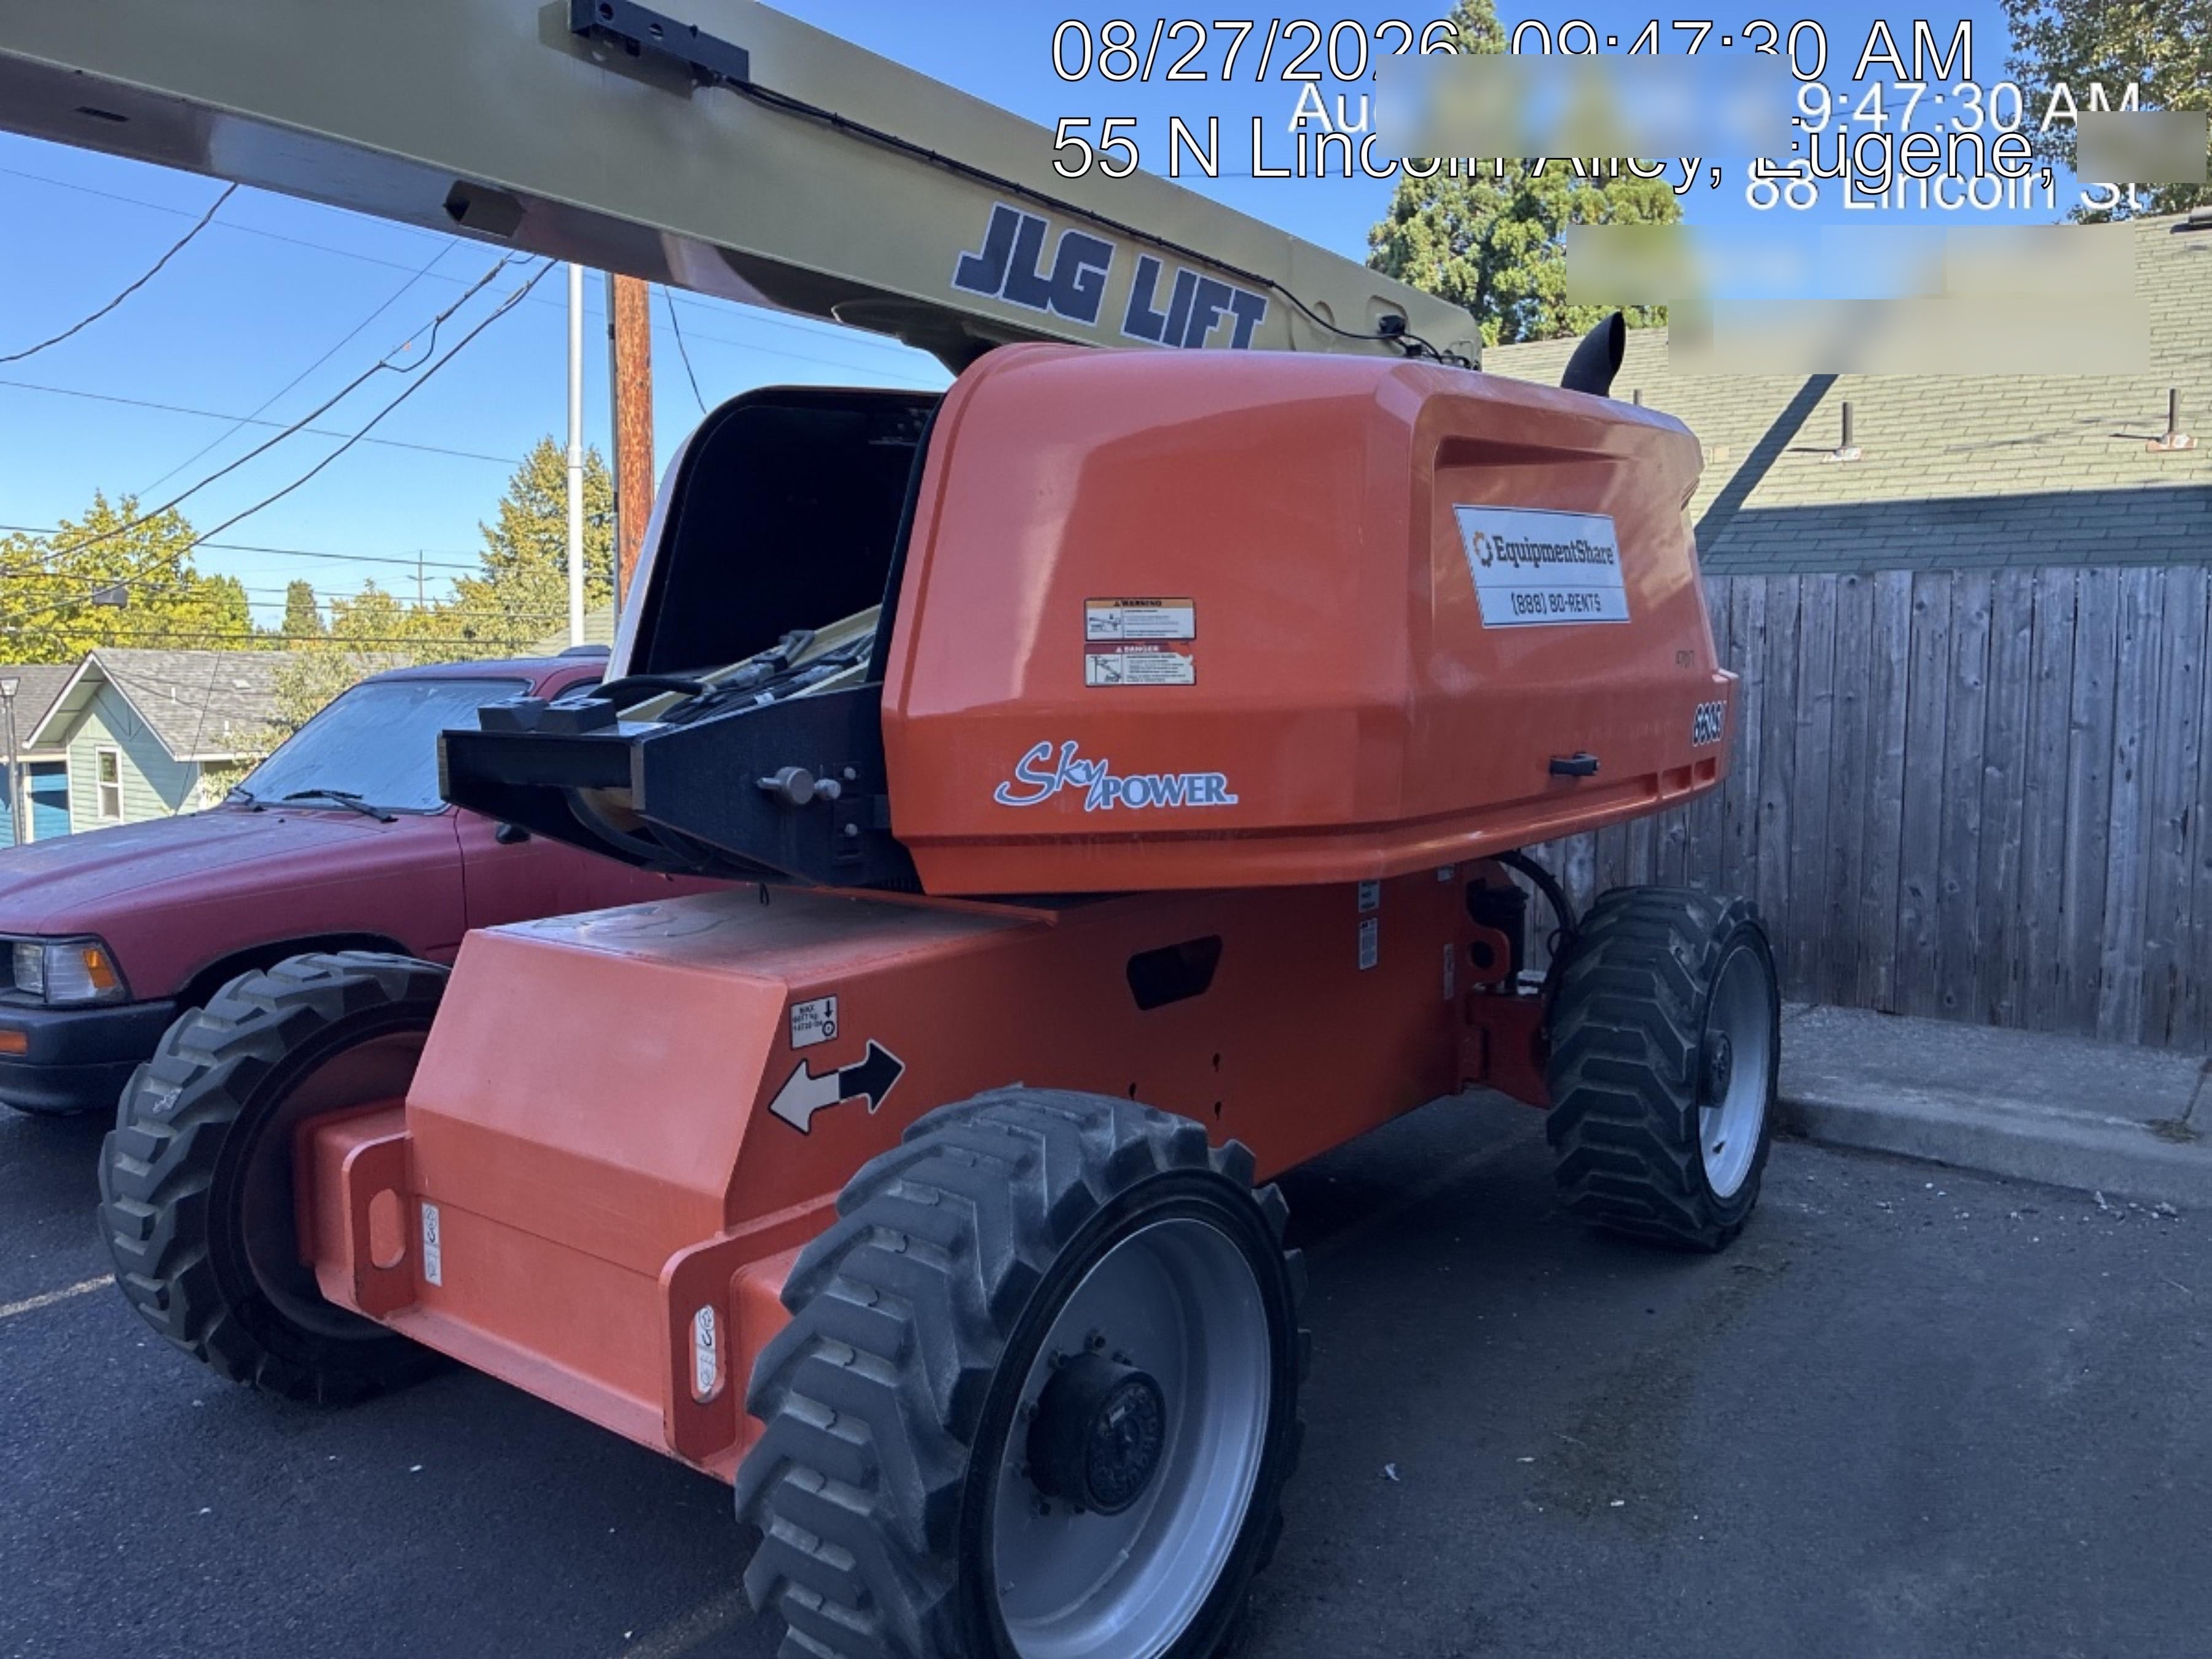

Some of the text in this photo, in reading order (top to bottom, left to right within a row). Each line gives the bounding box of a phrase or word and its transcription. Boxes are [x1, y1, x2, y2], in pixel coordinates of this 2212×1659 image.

[951, 201, 1269, 348] JLG LIFT
[1492, 536, 1615, 568] EquipmentShare
[994, 740, 1239, 812] Sky POWER
